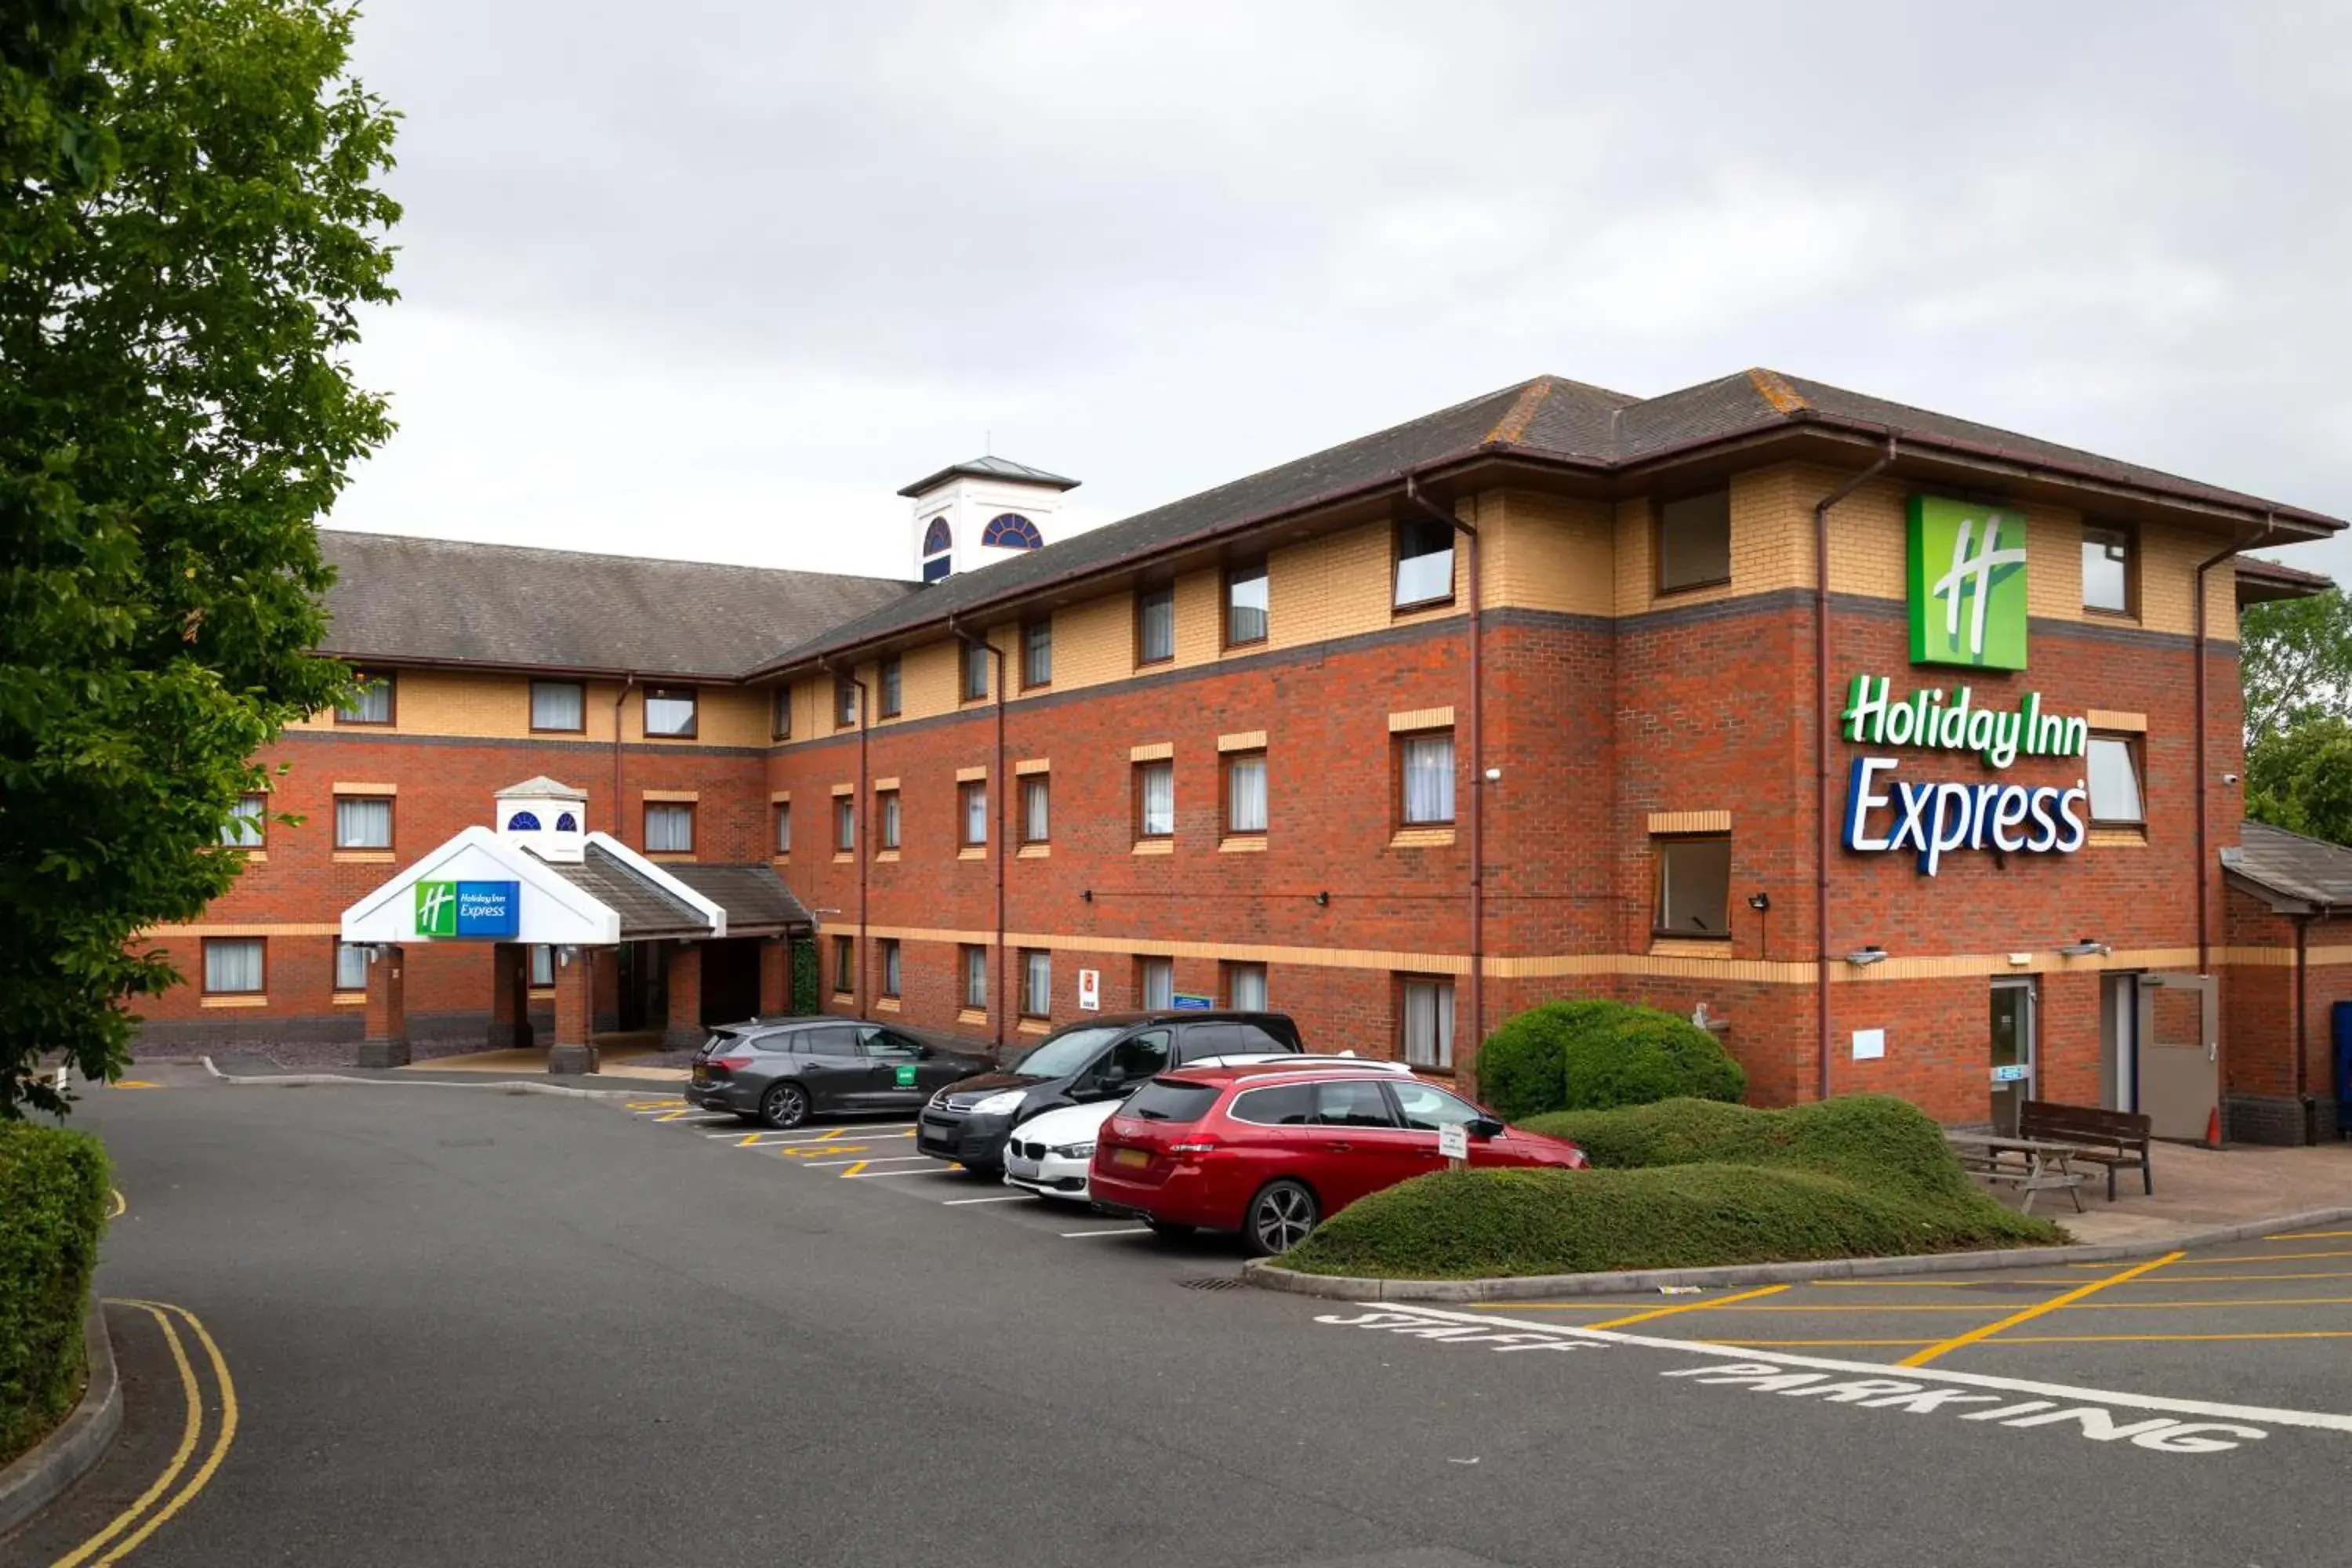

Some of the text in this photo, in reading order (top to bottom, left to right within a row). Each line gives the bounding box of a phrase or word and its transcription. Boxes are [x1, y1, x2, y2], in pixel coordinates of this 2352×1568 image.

[1846, 674, 2088, 769] Holiday Inn
[1848, 757, 2086, 877] Express
[460, 904, 505, 920] Express
[461, 893, 506, 905] Holiday Inn
[1313, 1312, 2269, 1453] STAFF PARKING
